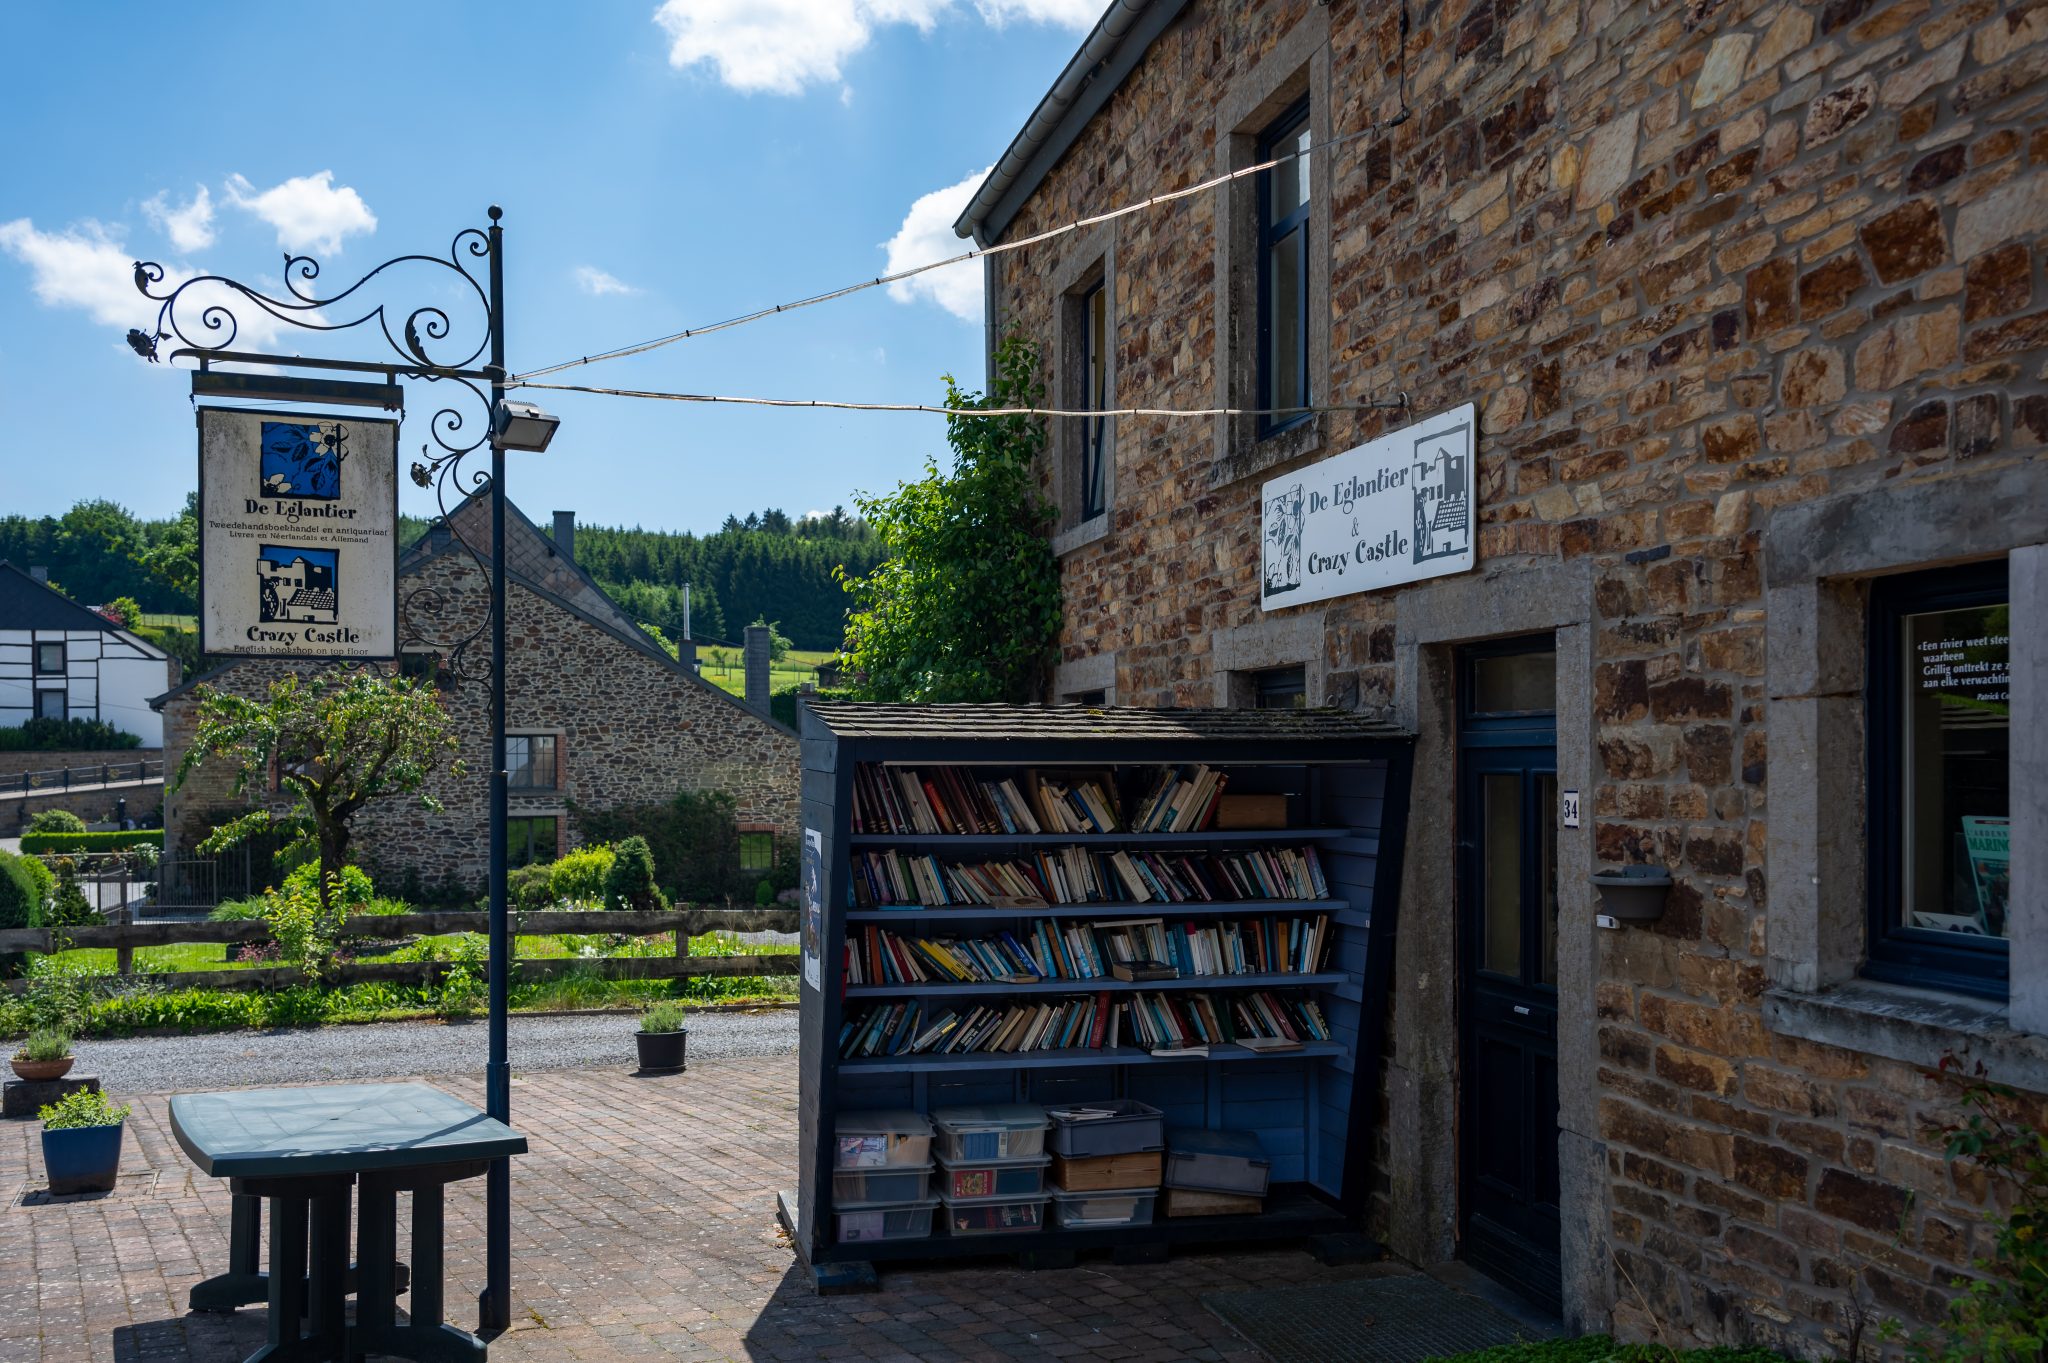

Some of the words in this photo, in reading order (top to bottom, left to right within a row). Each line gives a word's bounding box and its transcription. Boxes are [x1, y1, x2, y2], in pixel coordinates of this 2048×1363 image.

[1308, 491, 1328, 514] De
[1333, 465, 1409, 514] Eglantier
[243, 499, 269, 515] De
[274, 500, 357, 524] Eglantier
[208, 520, 319, 533] Tweedehandsboekhandel
[336, 527, 388, 536] antiquariaat
[1351, 517, 1359, 537] &
[270, 532, 317, 541] Néerlandais
[1308, 551, 1350, 576] Crazy
[1355, 529, 1409, 564] Castle
[246, 625, 298, 646] Crazy
[304, 627, 360, 644] Castle
[1940, 638, 1964, 649] rivier
[1966, 636, 1988, 647] weet
[233, 645, 266, 654] English
[269, 646, 313, 655] bookshop
[347, 647, 369, 655] floor
[1923, 652, 1965, 663] waarheen
[1923, 664, 1952, 677] Grillig
[1952, 661, 1989, 673] onttrekt
[1991, 662, 2002, 670] ze
[1923, 680, 1939, 688] aan
[1941, 675, 1959, 687] elke
[1976, 691, 1999, 701] Patrick
[1564, 799, 1578, 819] 34
